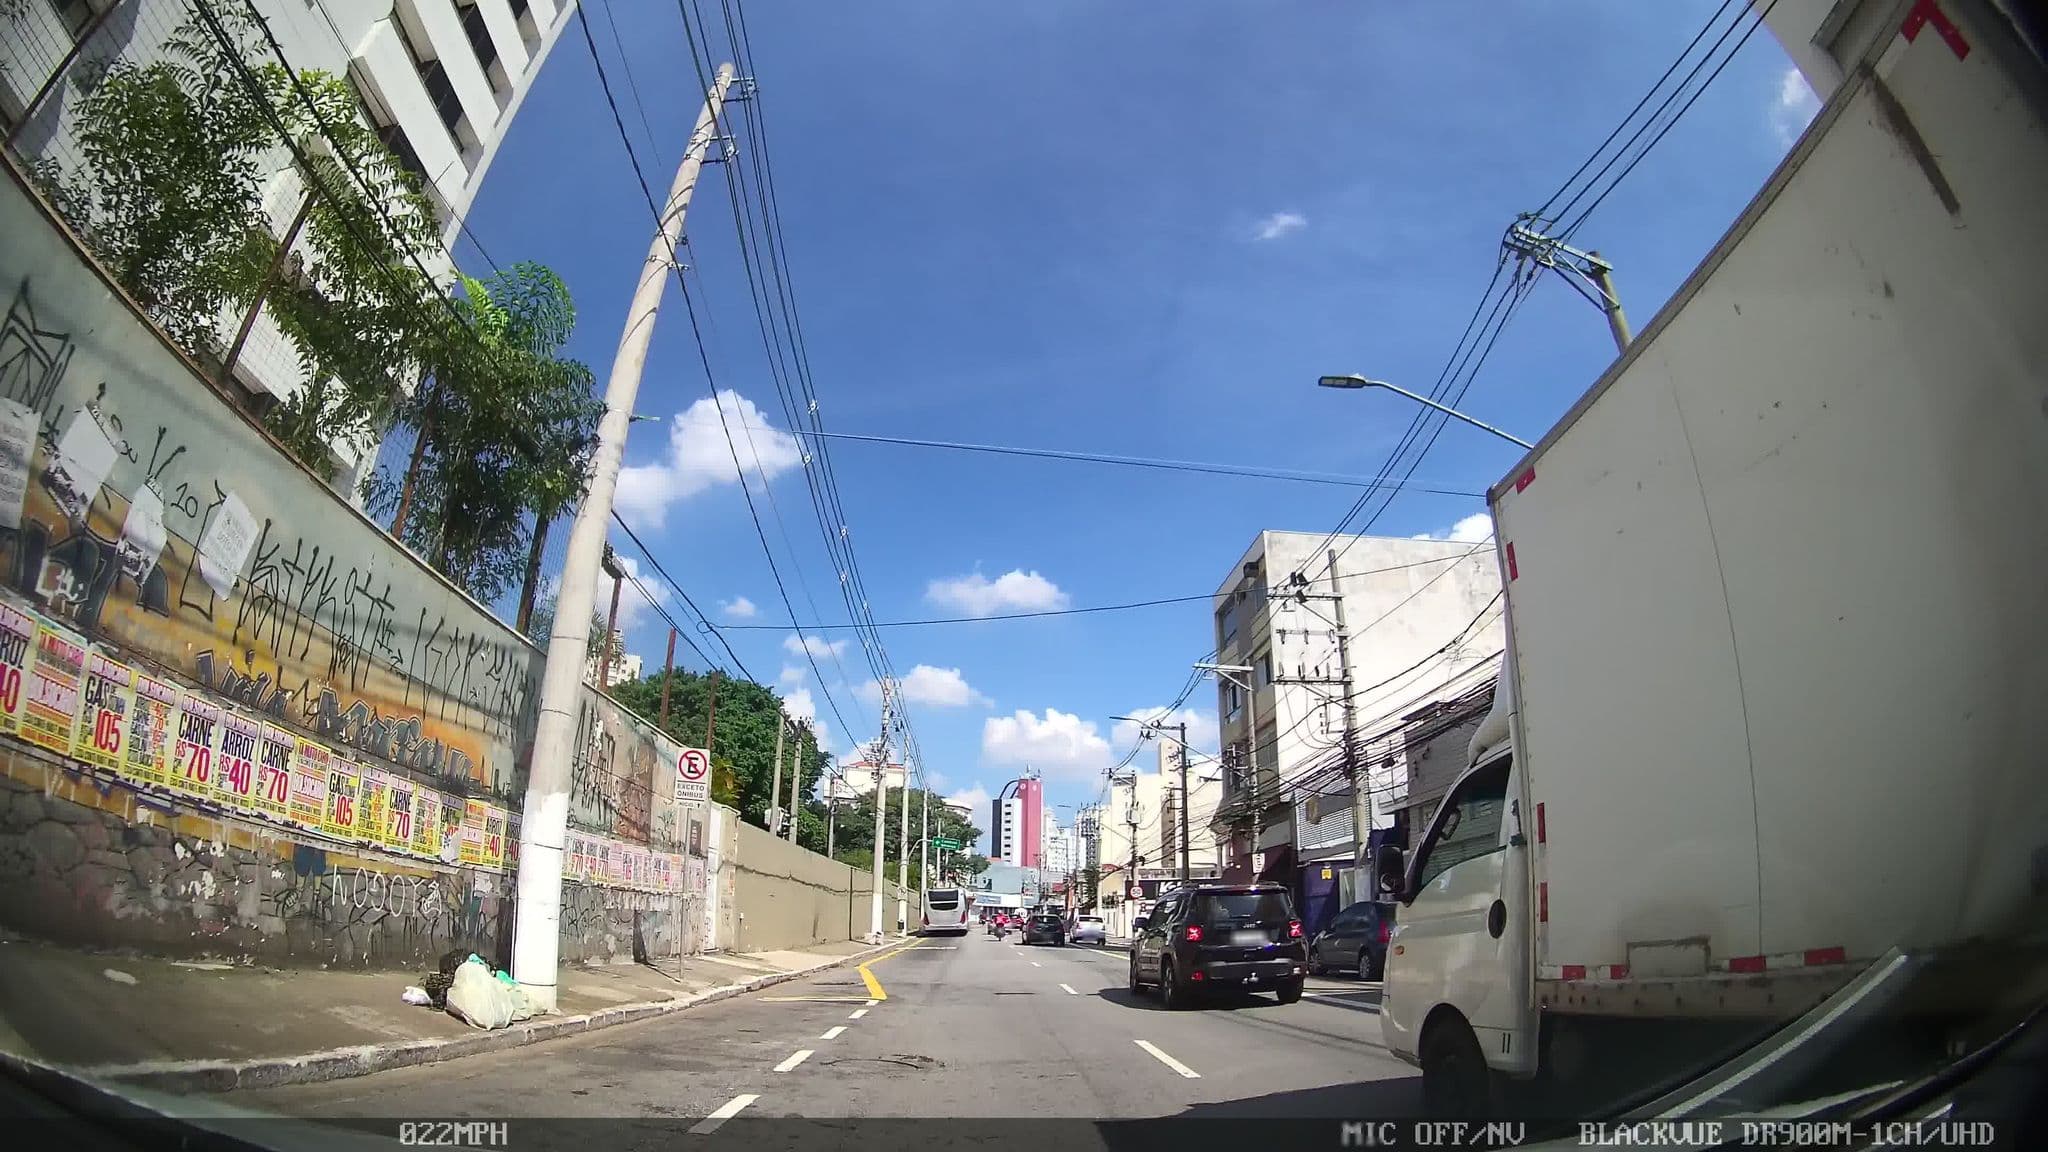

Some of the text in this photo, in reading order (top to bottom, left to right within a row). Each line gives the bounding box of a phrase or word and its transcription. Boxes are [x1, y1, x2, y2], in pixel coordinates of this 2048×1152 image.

[94, 709, 122, 753] 105
[179, 712, 215, 748] CARNE
[221, 730, 255, 761] ARROZ
[186, 744, 211, 782] 70
[261, 741, 292, 772] CARNE
[229, 759, 251, 795] 40
[268, 768, 288, 803] 70
[335, 795, 354, 827] 105
[390, 789, 413, 813] CARNE
[395, 812, 410, 839] 70
[489, 836, 501, 858] 40
